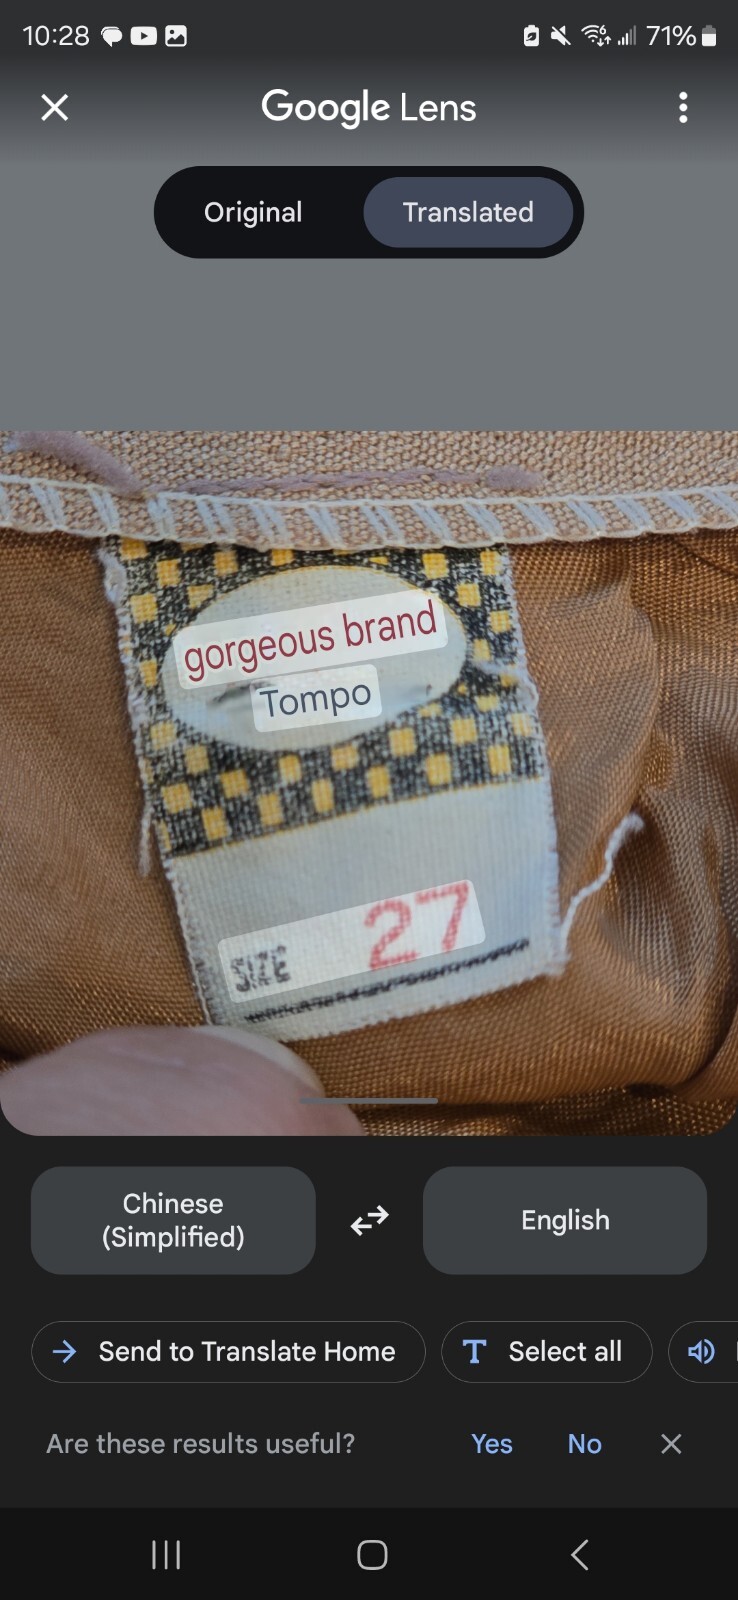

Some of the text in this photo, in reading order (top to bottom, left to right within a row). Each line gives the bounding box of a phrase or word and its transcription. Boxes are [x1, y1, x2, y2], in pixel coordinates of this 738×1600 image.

[22, 25, 90, 47] 10:28
[646, 25, 697, 47] 71%
[261, 88, 477, 130] Google Lens
[204, 199, 302, 228] Original
[402, 200, 534, 223] Translated
[230, 881, 471, 992] SIZE 27
[123, 1191, 224, 1215] Chinese
[522, 1207, 610, 1236] English
[102, 1224, 245, 1253] (Simplified)
[98, 1340, 396, 1362] Send to Translate Home
[508, 1339, 622, 1362] Select all
[46, 1432, 355, 1455] Are these results useful?
[471, 1433, 513, 1455] Yes
[568, 1433, 603, 1455] No
